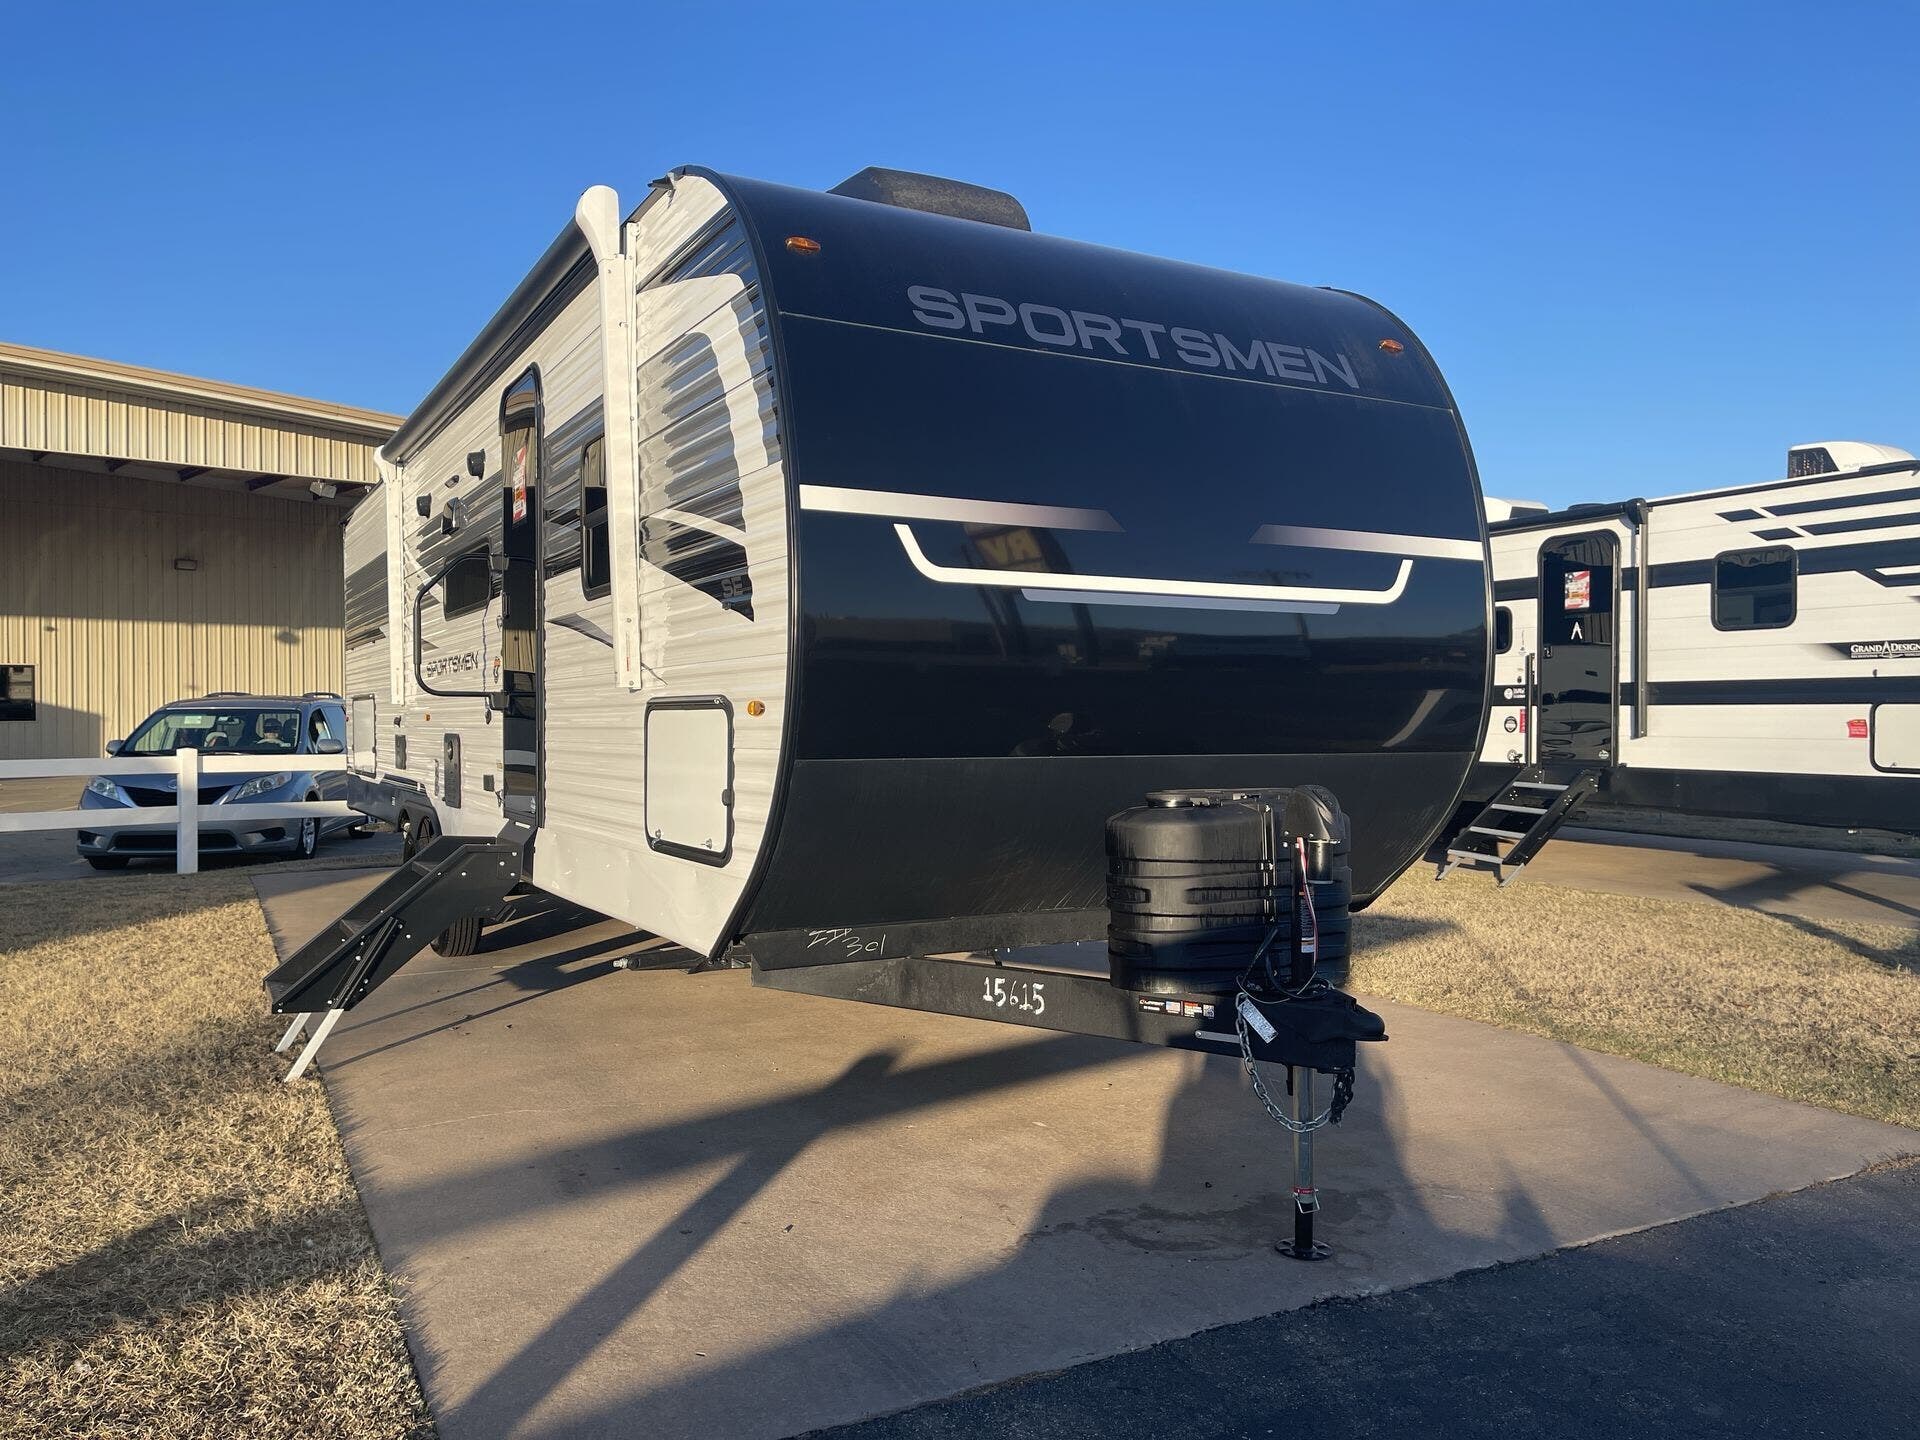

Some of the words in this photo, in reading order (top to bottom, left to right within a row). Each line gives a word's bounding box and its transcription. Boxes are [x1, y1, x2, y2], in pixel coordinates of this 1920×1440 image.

[907, 284, 1360, 389] SPORTSMEN
[1850, 644, 1883, 653] GRAND
[426, 651, 479, 678] SPORTSMEN
[841, 933, 886, 957] 301
[982, 976, 1045, 1015] 15615
